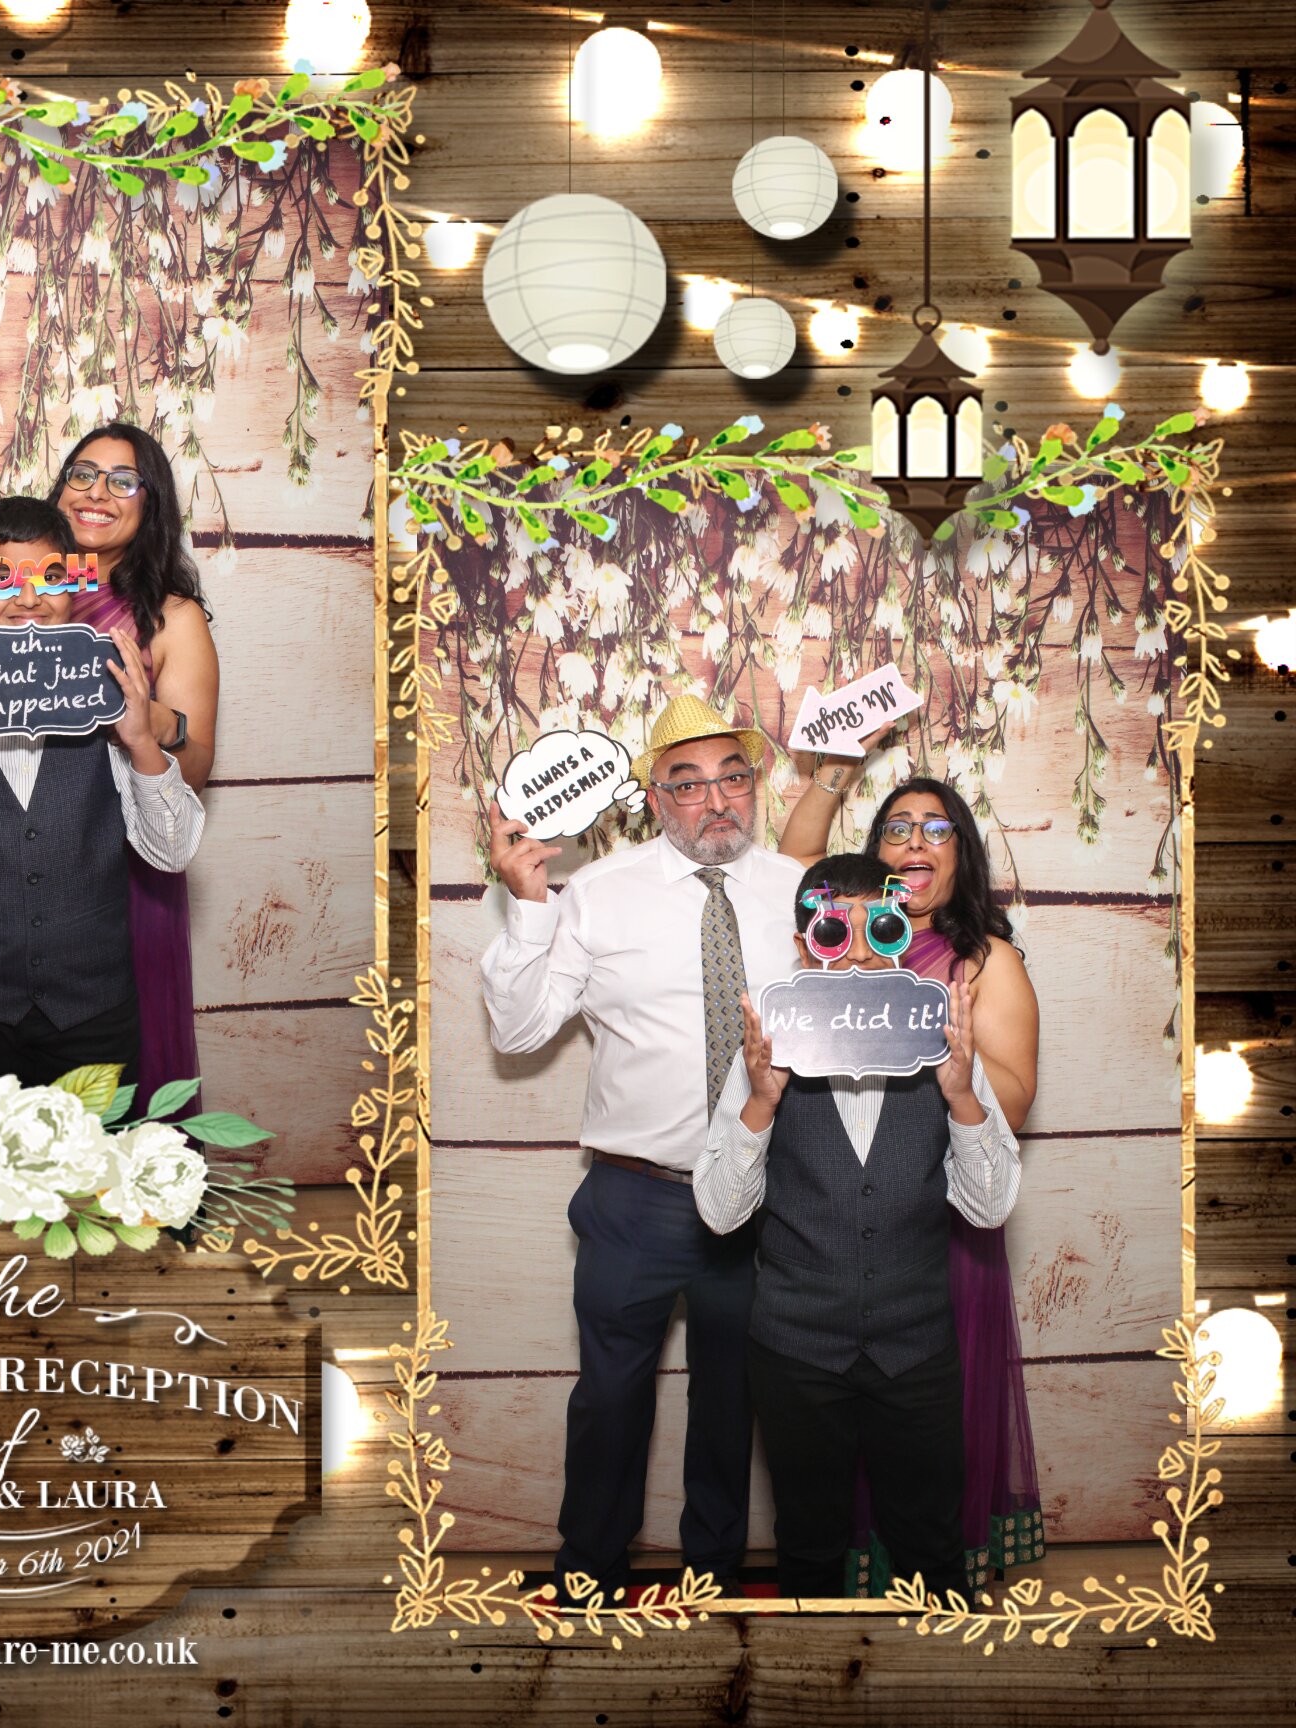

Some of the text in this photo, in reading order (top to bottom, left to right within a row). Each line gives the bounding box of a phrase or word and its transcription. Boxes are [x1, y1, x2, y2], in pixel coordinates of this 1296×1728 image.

[11, 632, 63, 655] uh...
[44, 656, 102, 690] just
[801, 681, 897, 747] Mr Right
[521, 746, 594, 799] ALWAYS A
[524, 760, 615, 827] BRIDESMAID
[768, 1002, 944, 1033] We did it!
